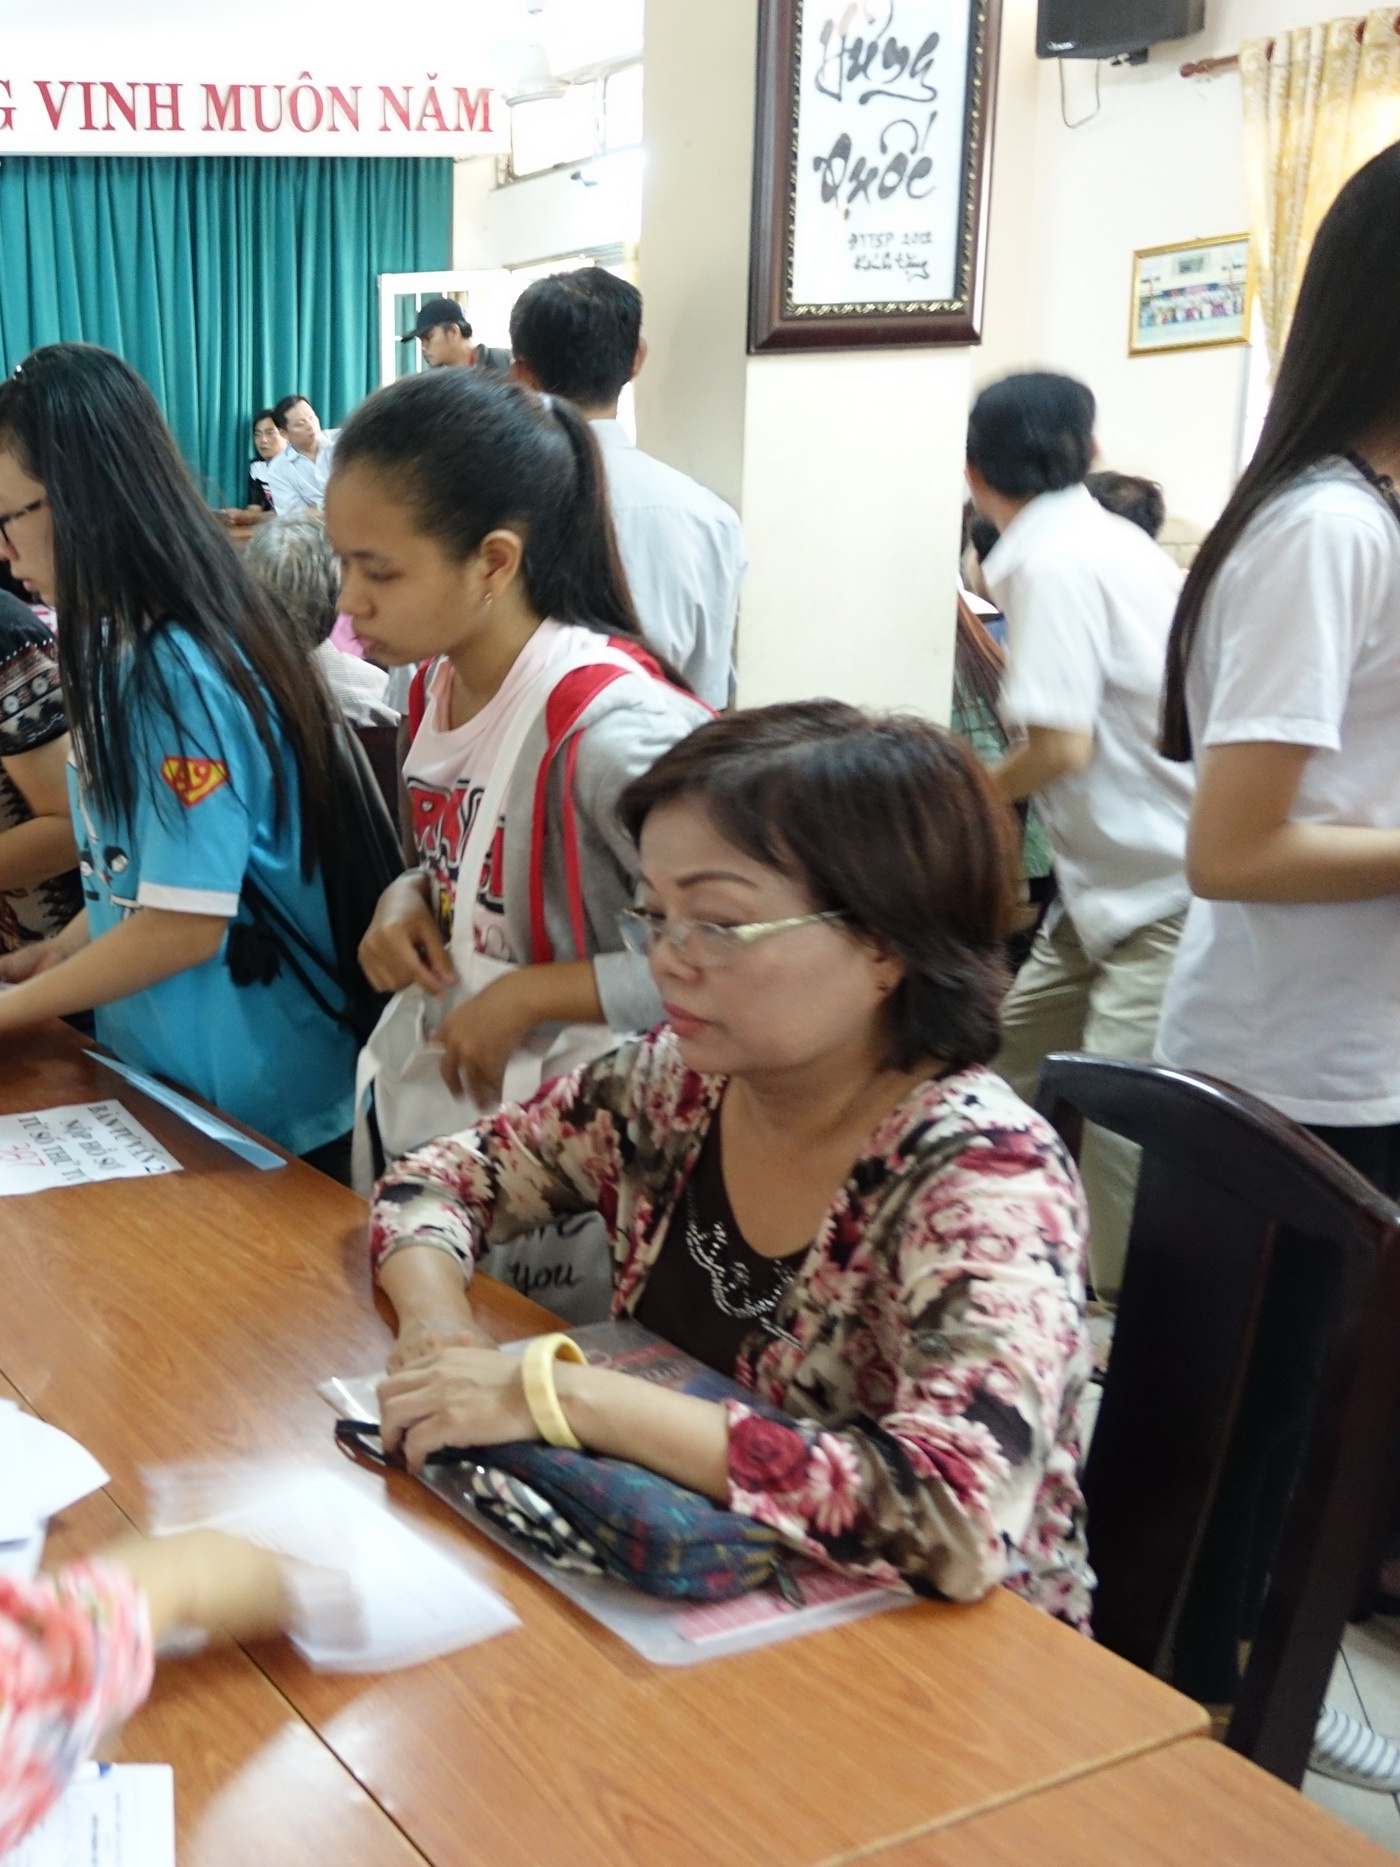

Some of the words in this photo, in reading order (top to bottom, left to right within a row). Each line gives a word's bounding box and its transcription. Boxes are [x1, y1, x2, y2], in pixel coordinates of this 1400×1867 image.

[34, 79, 185, 133] VINH
[200, 71, 362, 134] MUÔN
[378, 73, 496, 134] NĂM
